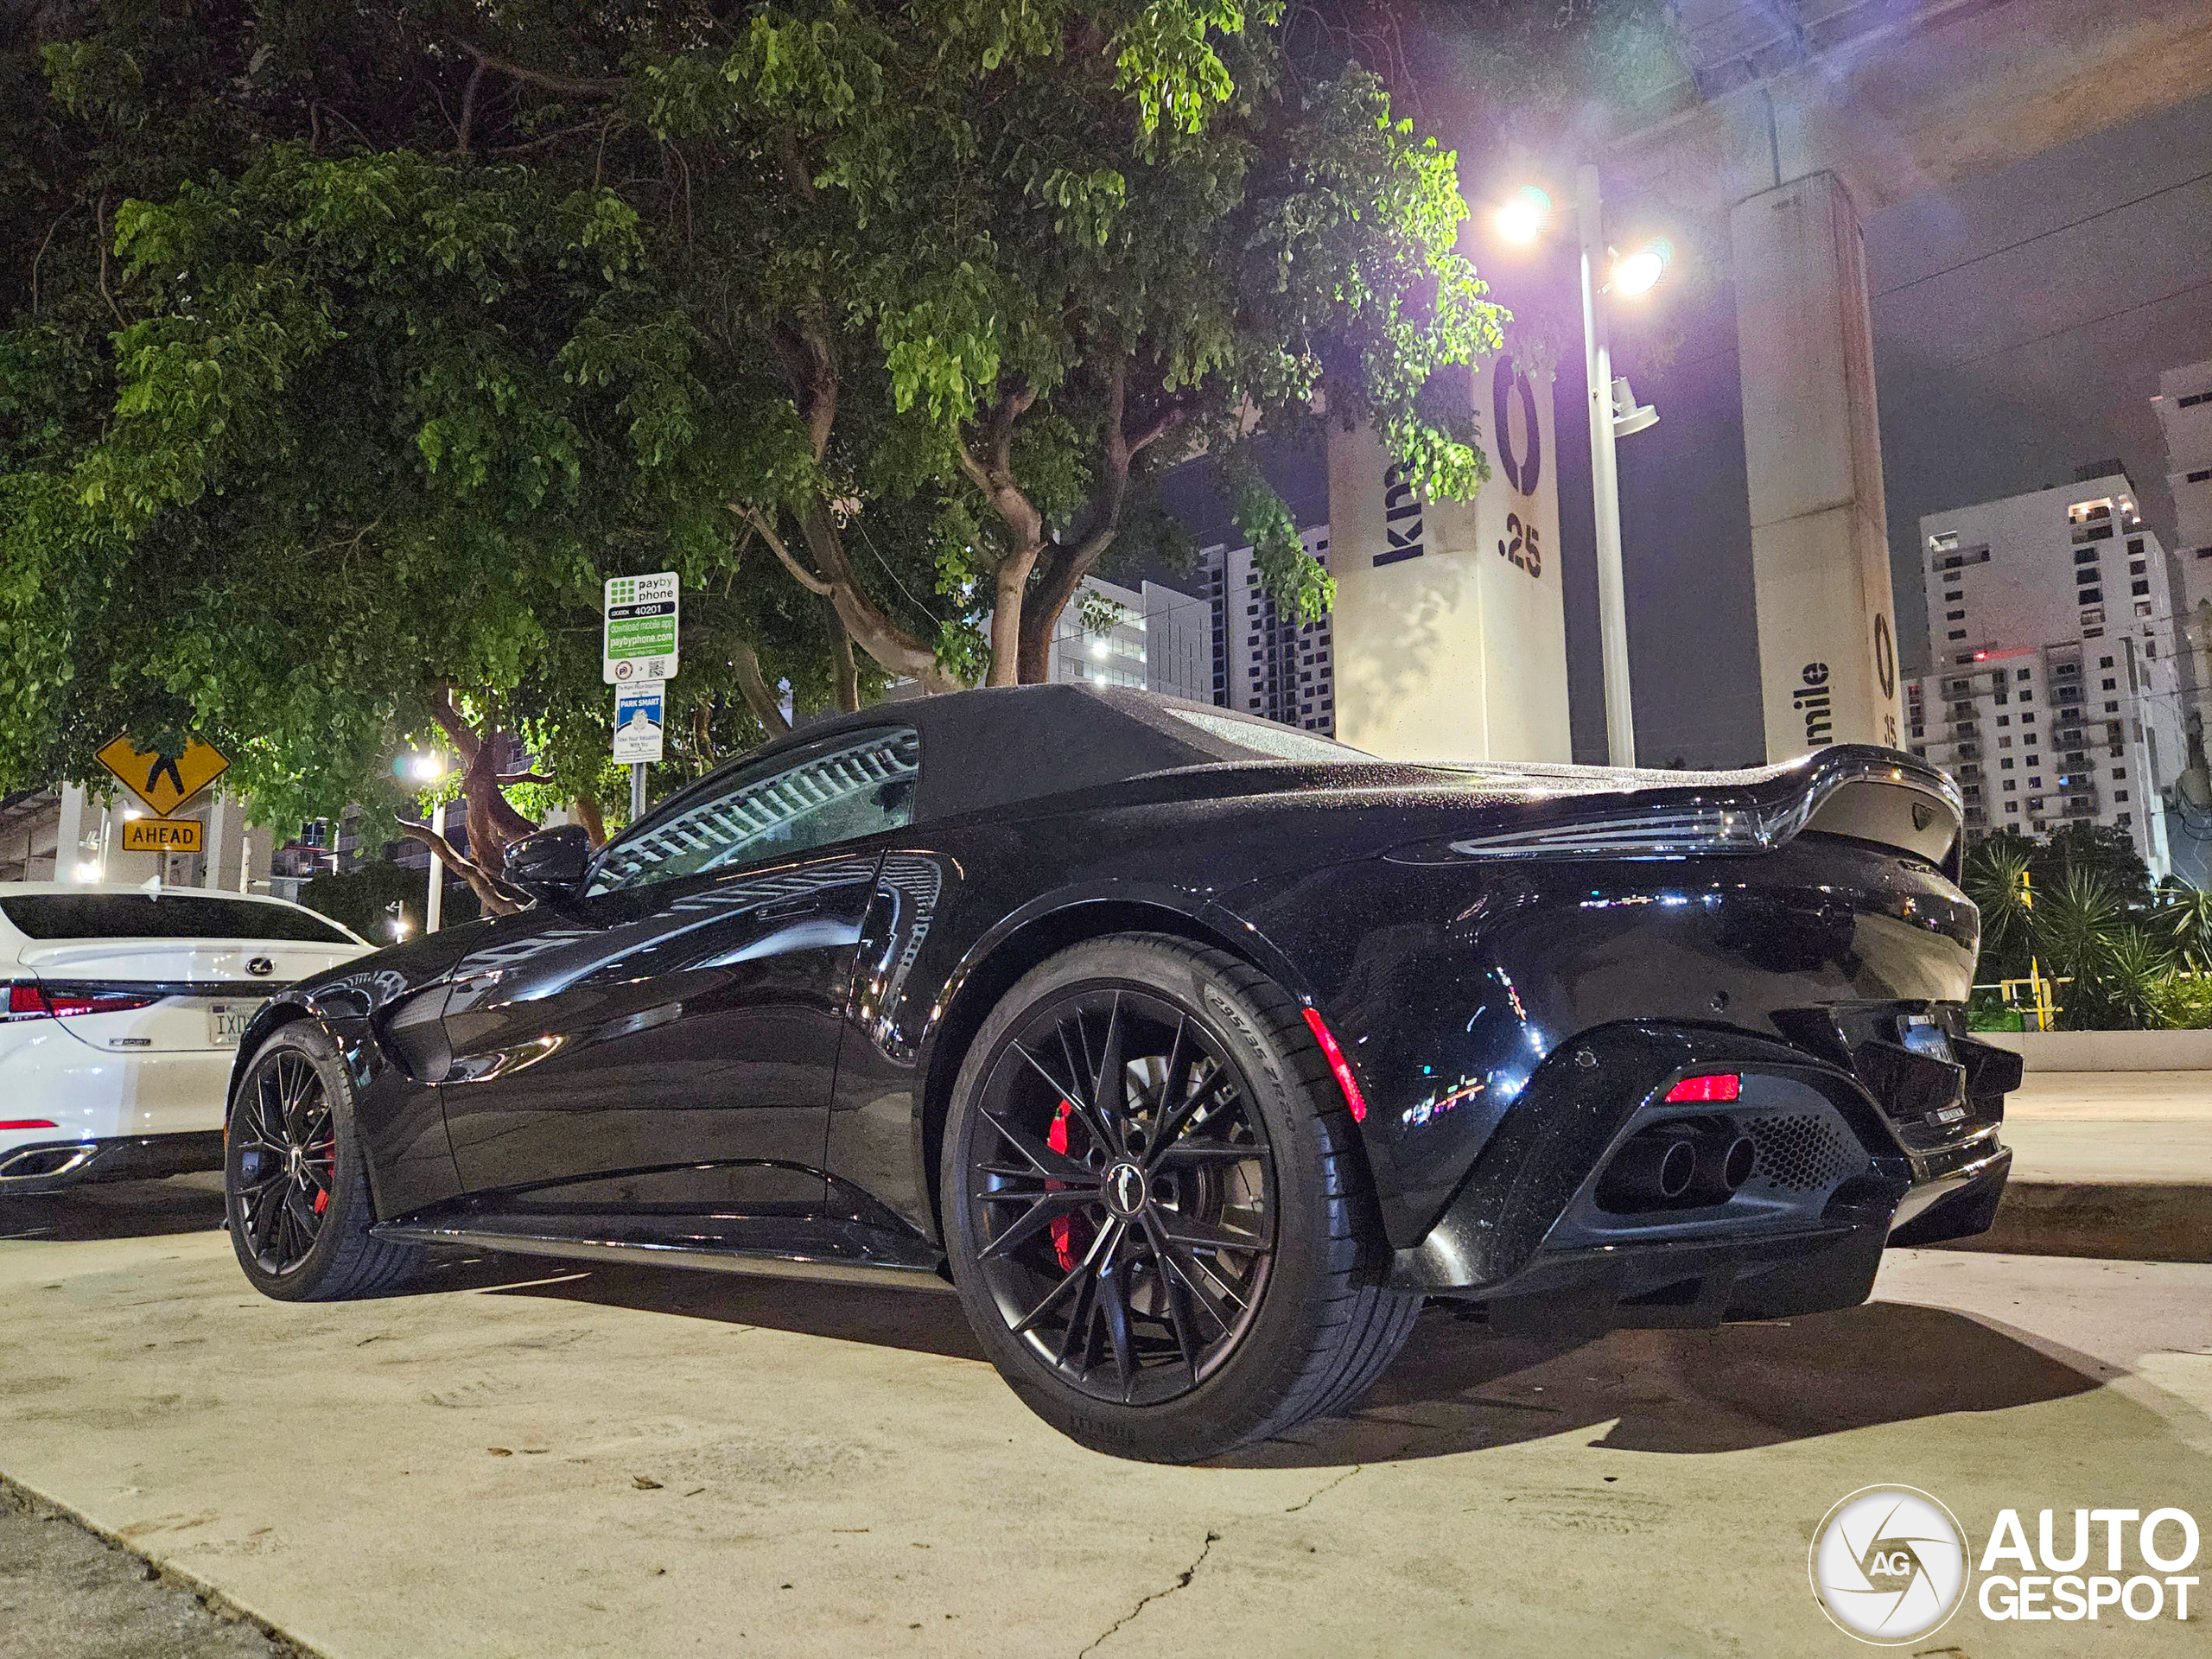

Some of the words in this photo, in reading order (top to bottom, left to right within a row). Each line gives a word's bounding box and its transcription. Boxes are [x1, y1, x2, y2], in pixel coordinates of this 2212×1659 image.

[639, 577, 672, 590] payby
[639, 589, 673, 602] phone
[635, 604, 661, 615] 40201
[611, 621, 639, 633] download
[640, 620, 660, 630] mobile
[661, 620, 672, 631] app
[610, 632, 673, 649] paybyphone.com
[620, 700, 638, 709] PARK
[638, 697, 659, 707] SMART
[1793, 662, 1833, 746] mile
[132, 827, 194, 844] AHEAD
[1210, 995, 1268, 1060] 295/35
